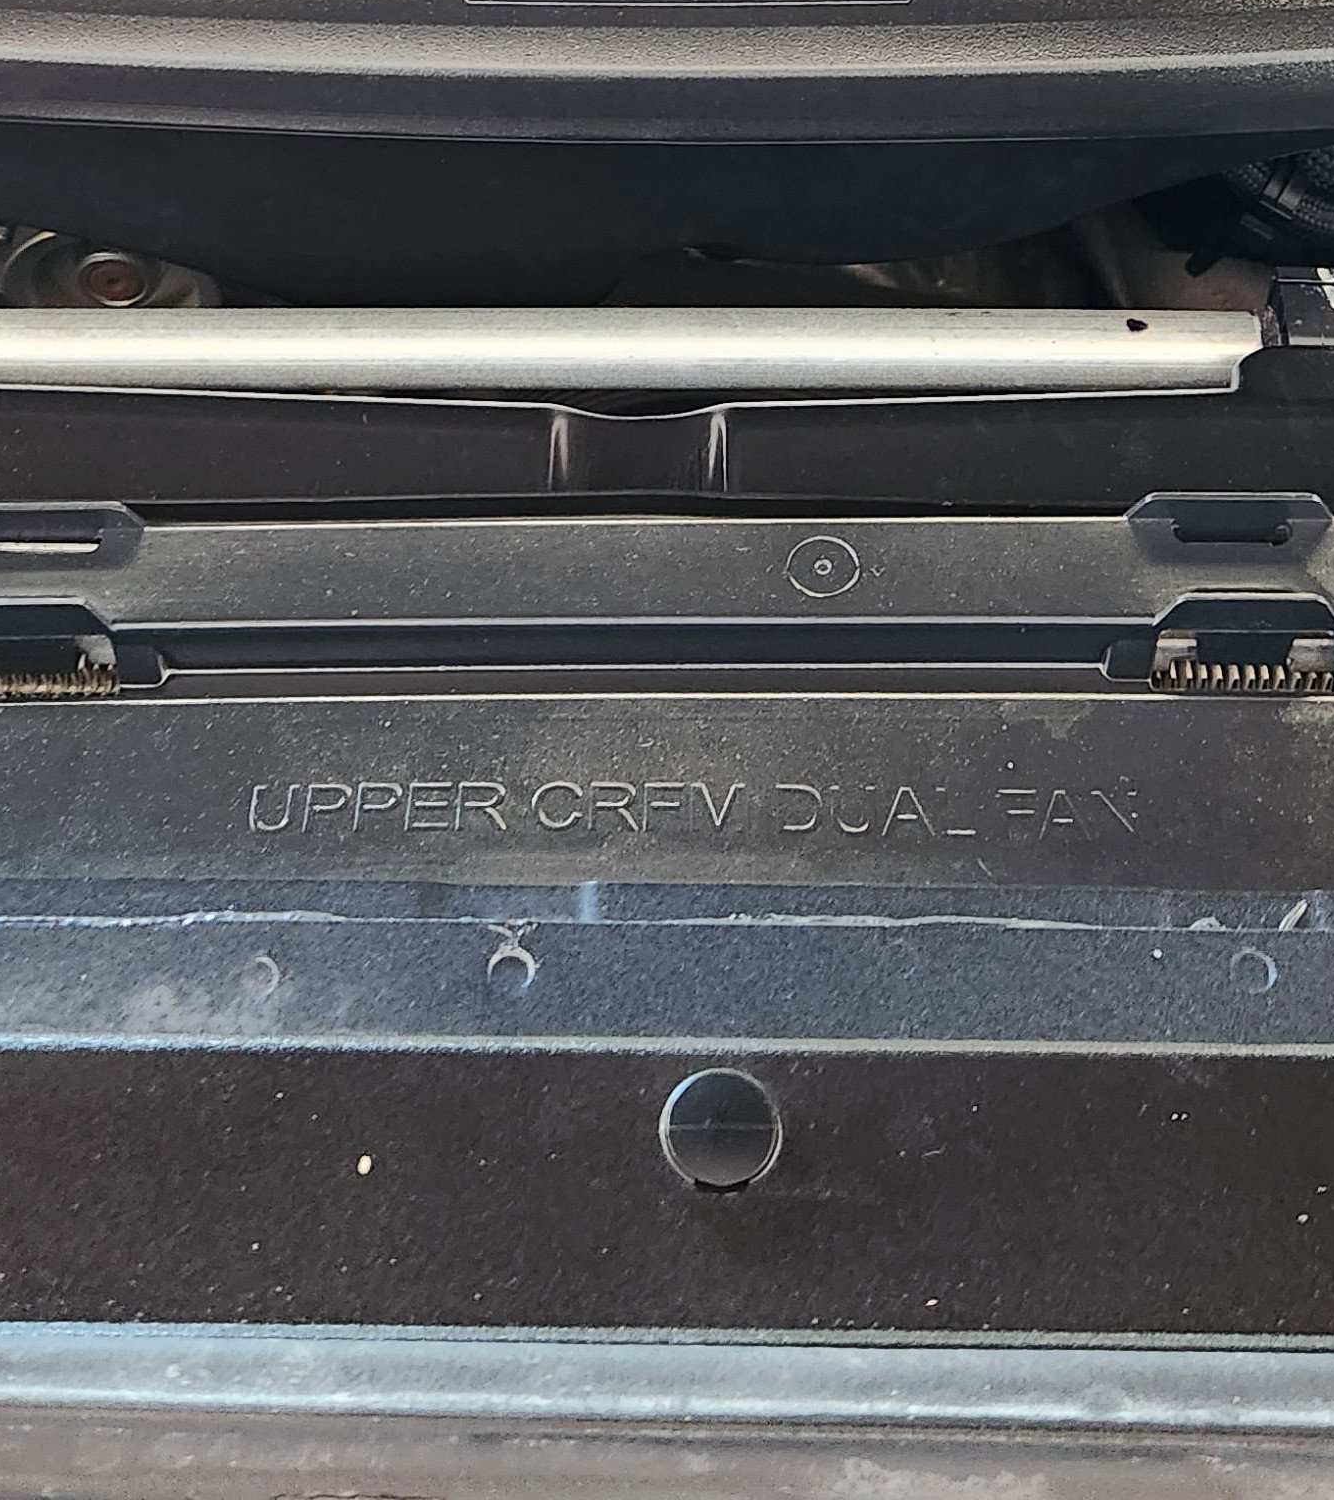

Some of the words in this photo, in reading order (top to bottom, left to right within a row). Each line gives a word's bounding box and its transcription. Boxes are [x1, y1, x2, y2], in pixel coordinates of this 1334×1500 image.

[248, 780, 508, 833] UPPER
[773, 782, 977, 837] DUAL
[992, 787, 1140, 841] FAN
